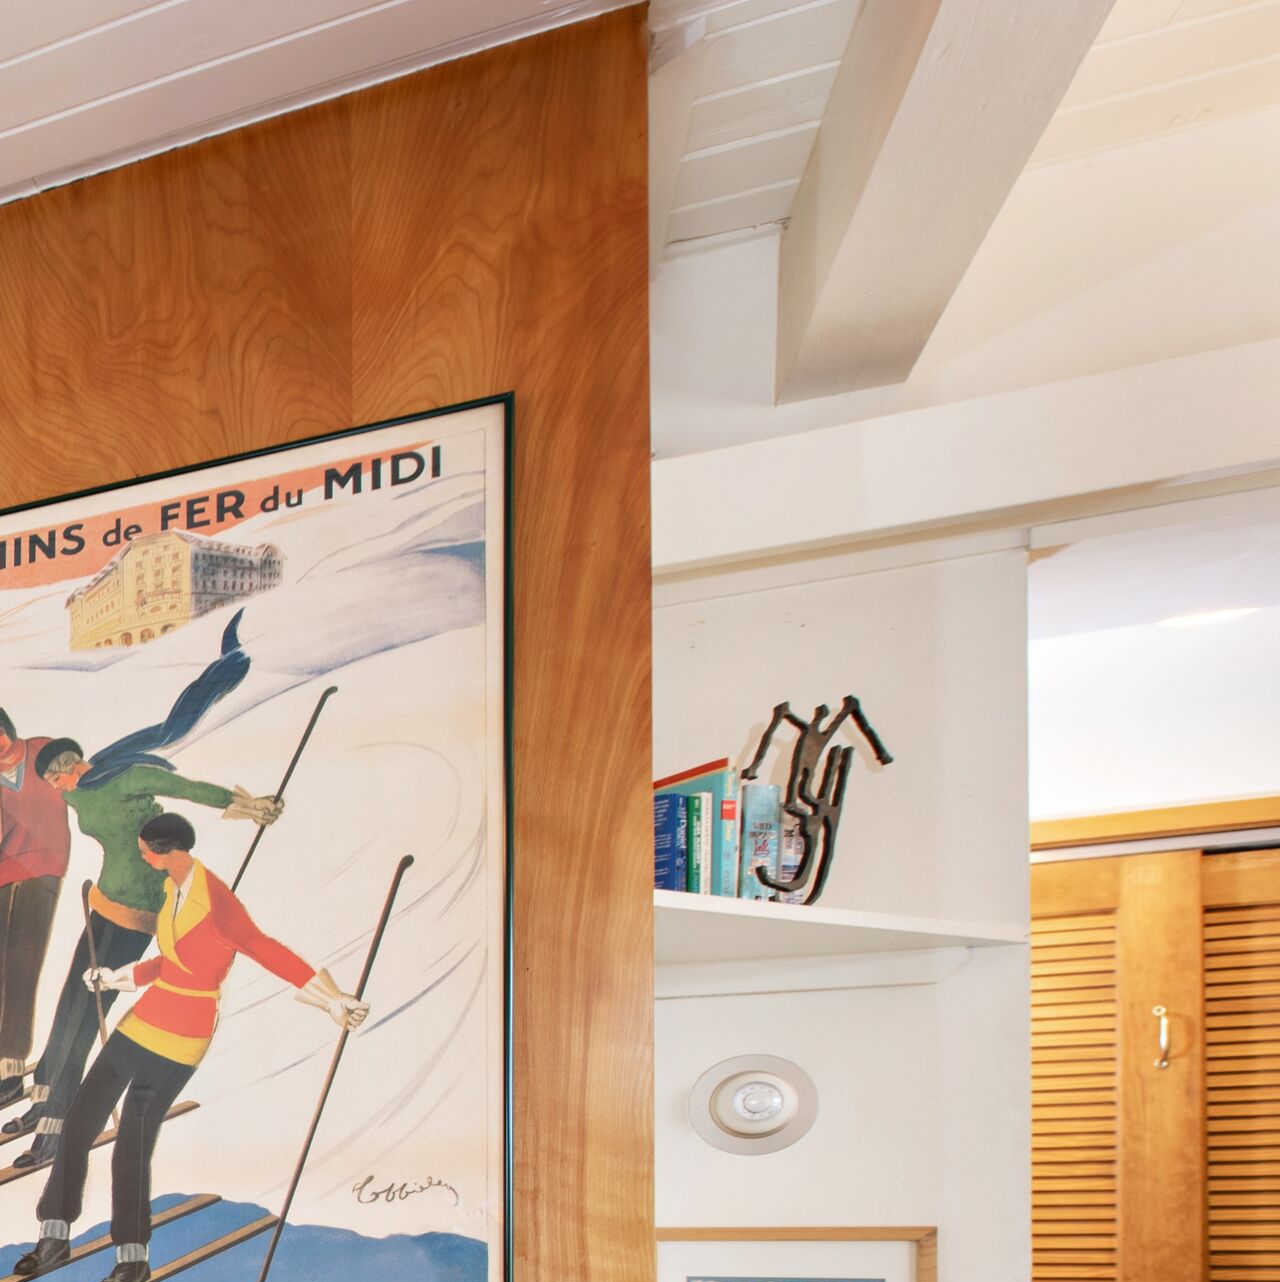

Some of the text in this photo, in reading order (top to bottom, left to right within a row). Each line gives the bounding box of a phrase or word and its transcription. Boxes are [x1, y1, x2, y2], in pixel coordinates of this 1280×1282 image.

[102, 519, 142, 548] de
[160, 490, 245, 531] FER
[260, 486, 304, 514] du
[324, 446, 441, 500] MIDI
